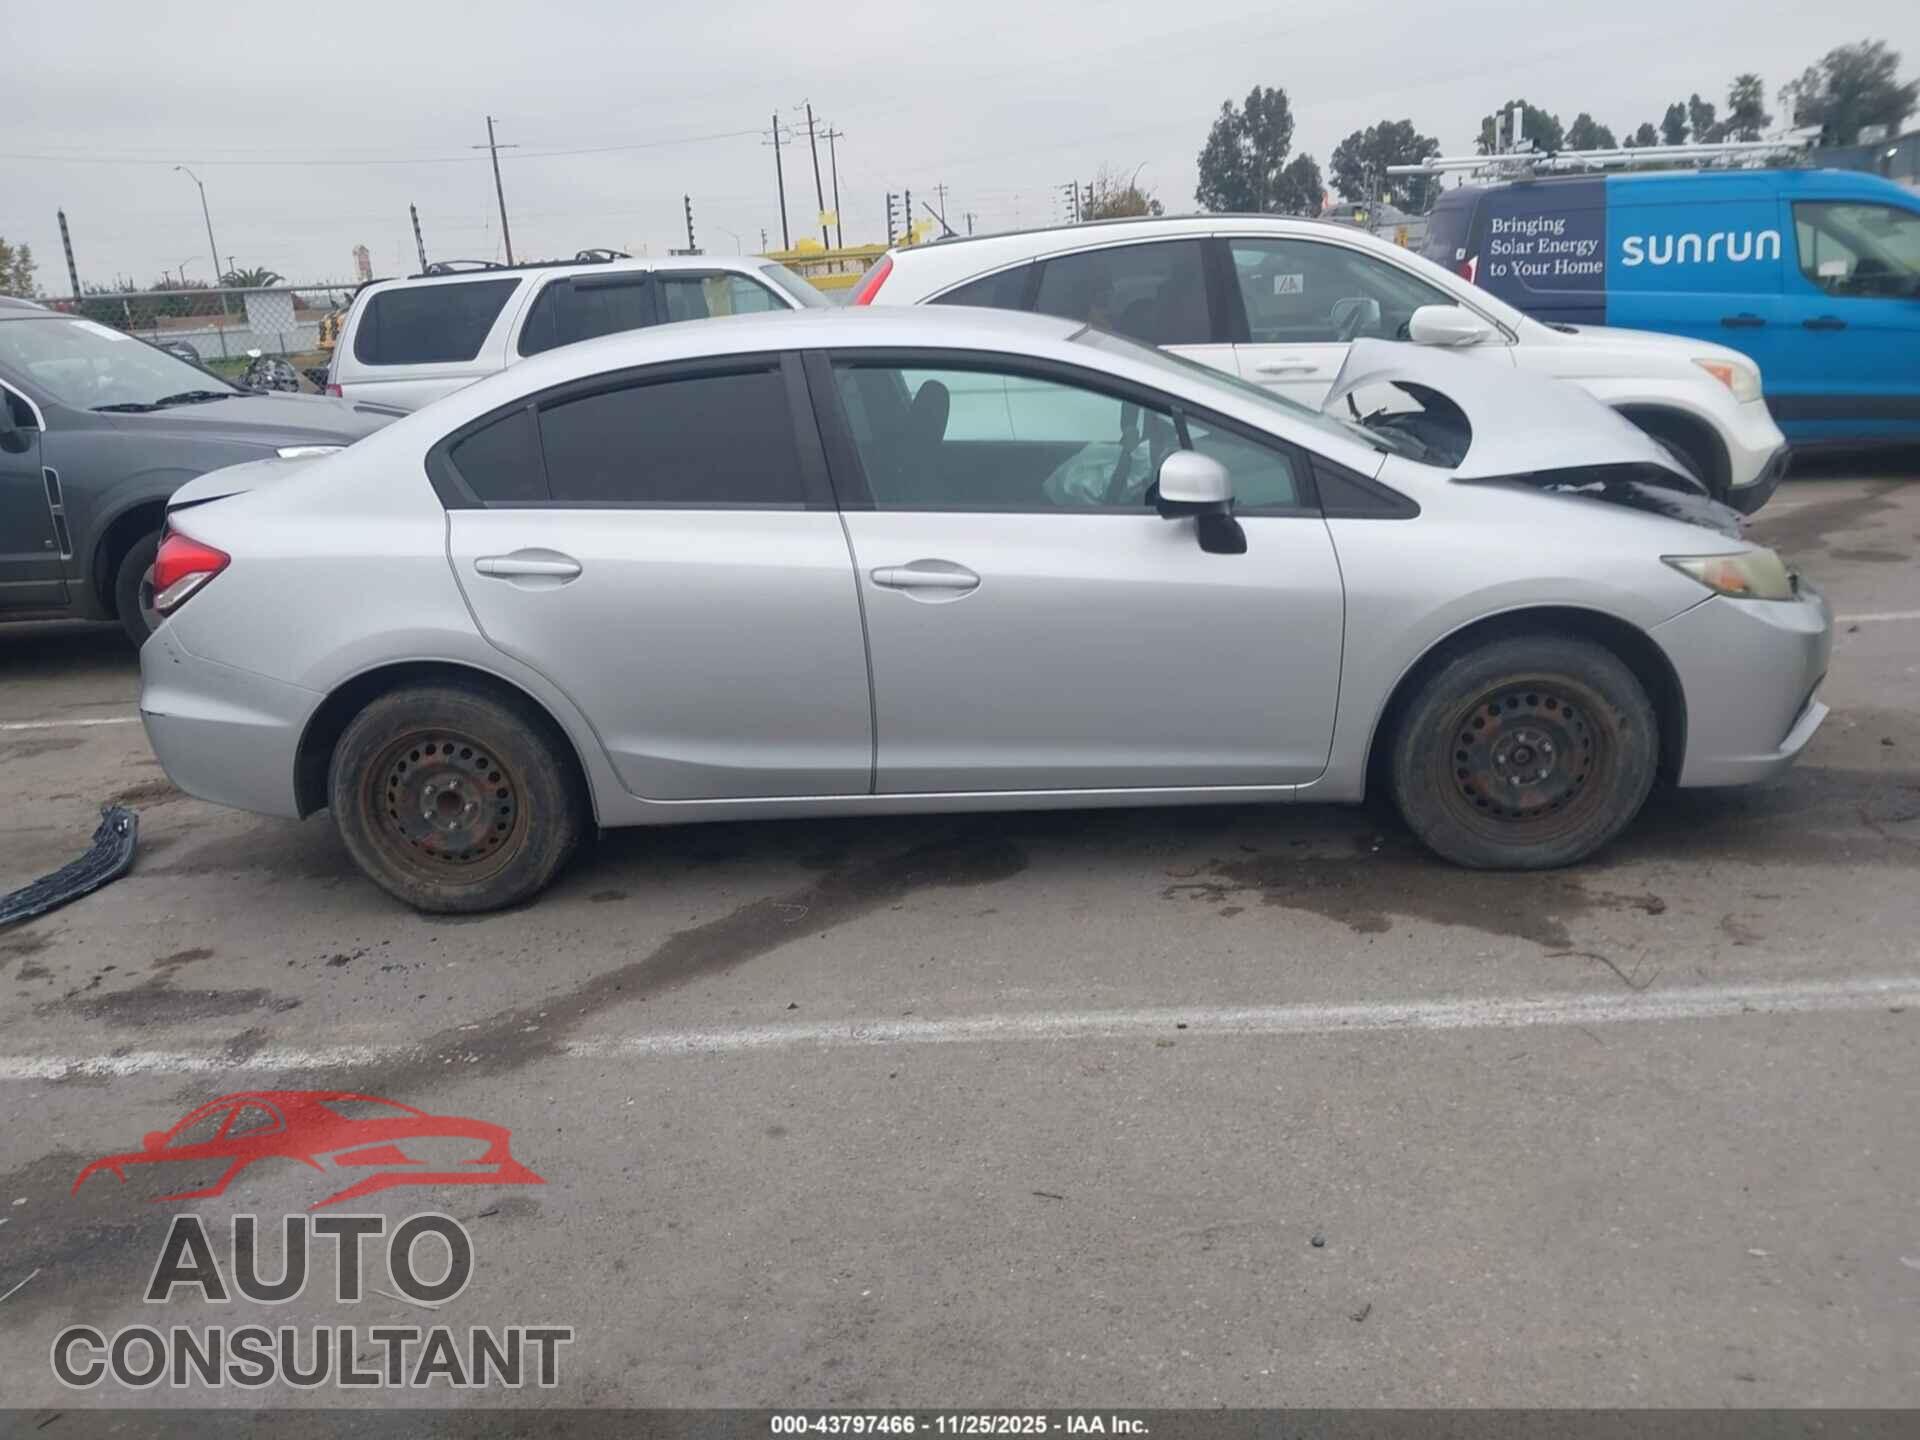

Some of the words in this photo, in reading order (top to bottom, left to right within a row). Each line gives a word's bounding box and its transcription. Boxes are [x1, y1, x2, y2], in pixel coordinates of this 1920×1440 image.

[1491, 216, 1566, 236] Bringing
[1490, 238, 1535, 255] Solar
[1538, 238, 1599, 256] Energy
[1621, 229, 1781, 266] sunrun
[1490, 262, 1507, 277] to
[1511, 260, 1551, 276] Your
[1554, 259, 1604, 275] Home
